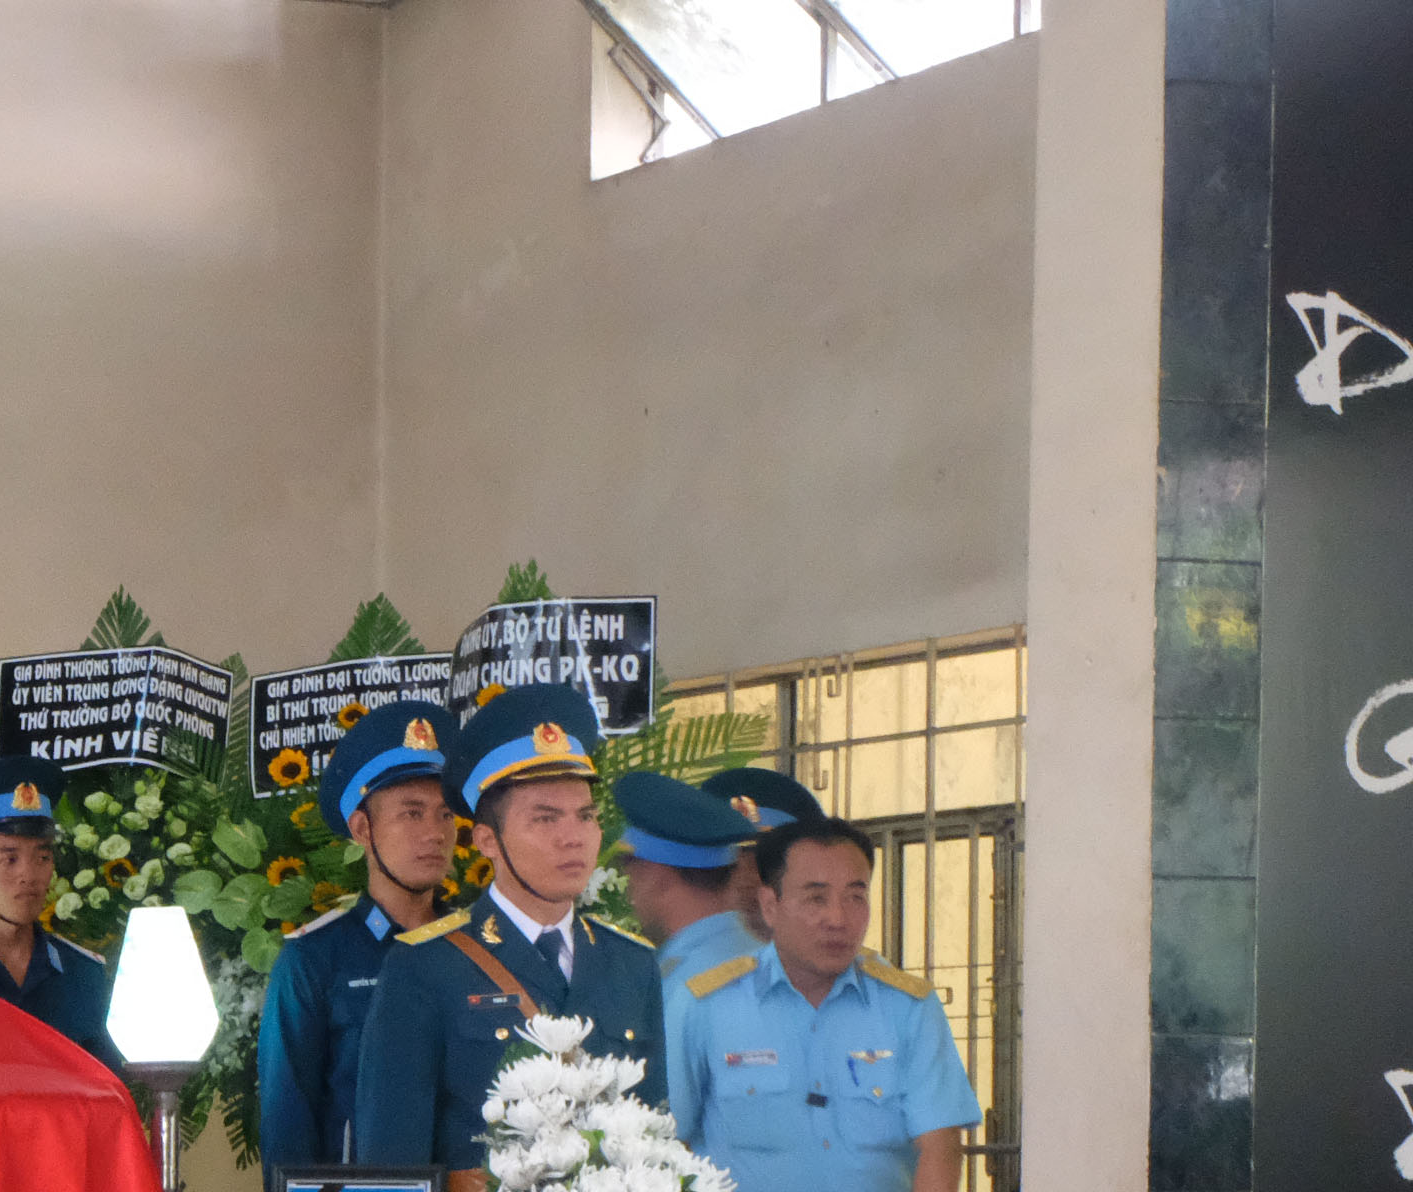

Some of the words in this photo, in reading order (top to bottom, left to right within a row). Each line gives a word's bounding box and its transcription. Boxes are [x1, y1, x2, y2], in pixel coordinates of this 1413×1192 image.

[567, 609, 624, 648] LỆNH
[14, 664, 32, 682] GIA
[34, 660, 61, 681] ĐÌNH
[64, 657, 109, 681] THƯỢNG
[112, 654, 147, 676] TƯỚNG
[149, 656, 178, 676] PHAN
[199, 668, 227, 694] GIANG
[267, 679, 288, 698] GIA
[291, 674, 323, 696] ĐÌNH
[327, 670, 350, 692] ĐẠI
[354, 661, 401, 686] TƯỚNG
[405, 660, 450, 683] LƯƠNG
[560, 654, 639, 682] PK-KQ
[12, 680, 30, 706] ỦY
[33, 679, 62, 704] VIÊN
[66, 680, 109, 703] TRUNG
[112, 677, 147, 699] ƯƠNG
[149, 673, 183, 701] ĐẢNG
[19, 707, 48, 732] THỨ
[51, 702, 108, 730] TRƯỞNG
[112, 698, 132, 723] BỘ
[135, 698, 172, 725] QUỐC
[175, 709, 214, 740] PHÒNG
[266, 702, 280, 722] BÍ
[283, 699, 310, 721] THƯ
[31, 734, 103, 760] KÍNH
[259, 726, 280, 751] CHỦ
[282, 724, 316, 748] NHIỆM
